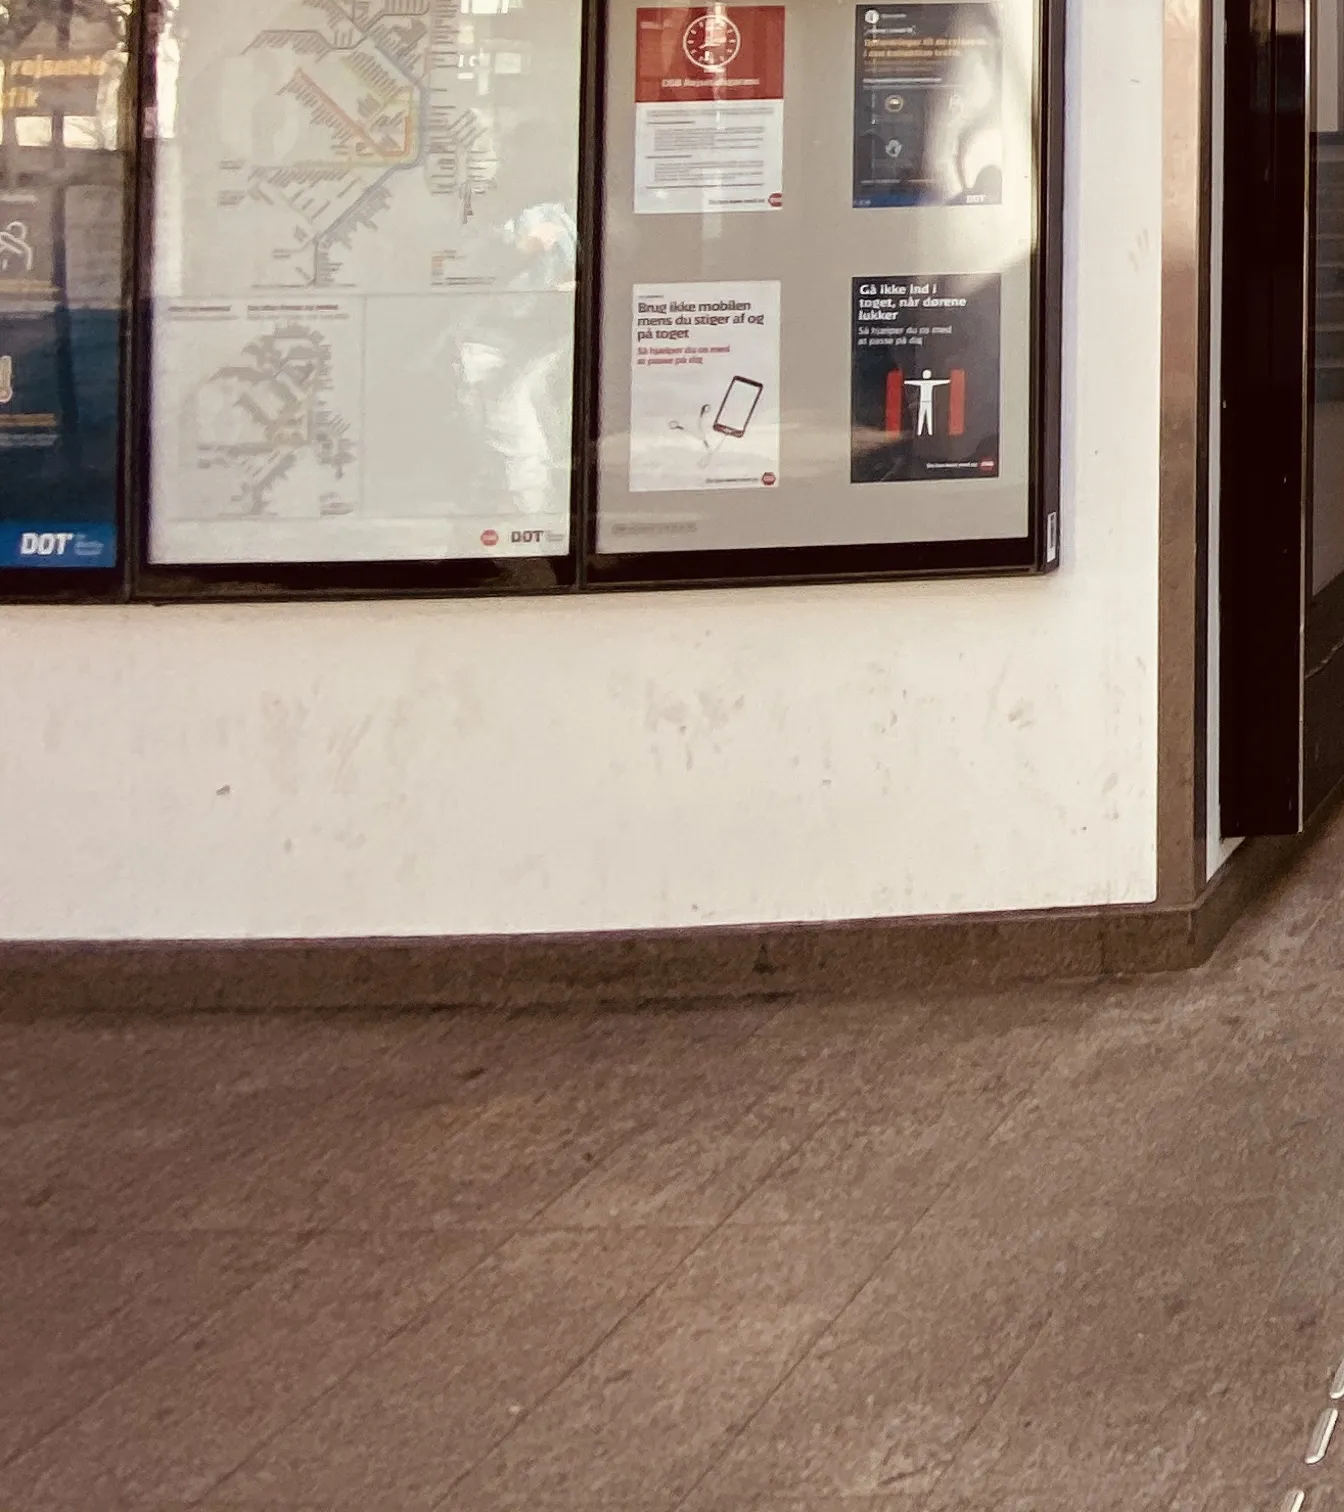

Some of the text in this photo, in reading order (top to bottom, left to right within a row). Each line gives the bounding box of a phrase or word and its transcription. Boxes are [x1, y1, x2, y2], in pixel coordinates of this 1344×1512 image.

[880, 284, 907, 295] ikke
[909, 284, 930, 294] ind
[638, 300, 751, 314] Brug ikke mobilen
[637, 317, 673, 326] mens
[675, 314, 692, 326] du
[733, 313, 745, 324] af
[747, 314, 764, 325] og
[858, 310, 899, 321] lukker
[637, 329, 690, 342] på toget
[511, 531, 544, 542] DOT
[20, 531, 74, 556] DOT
